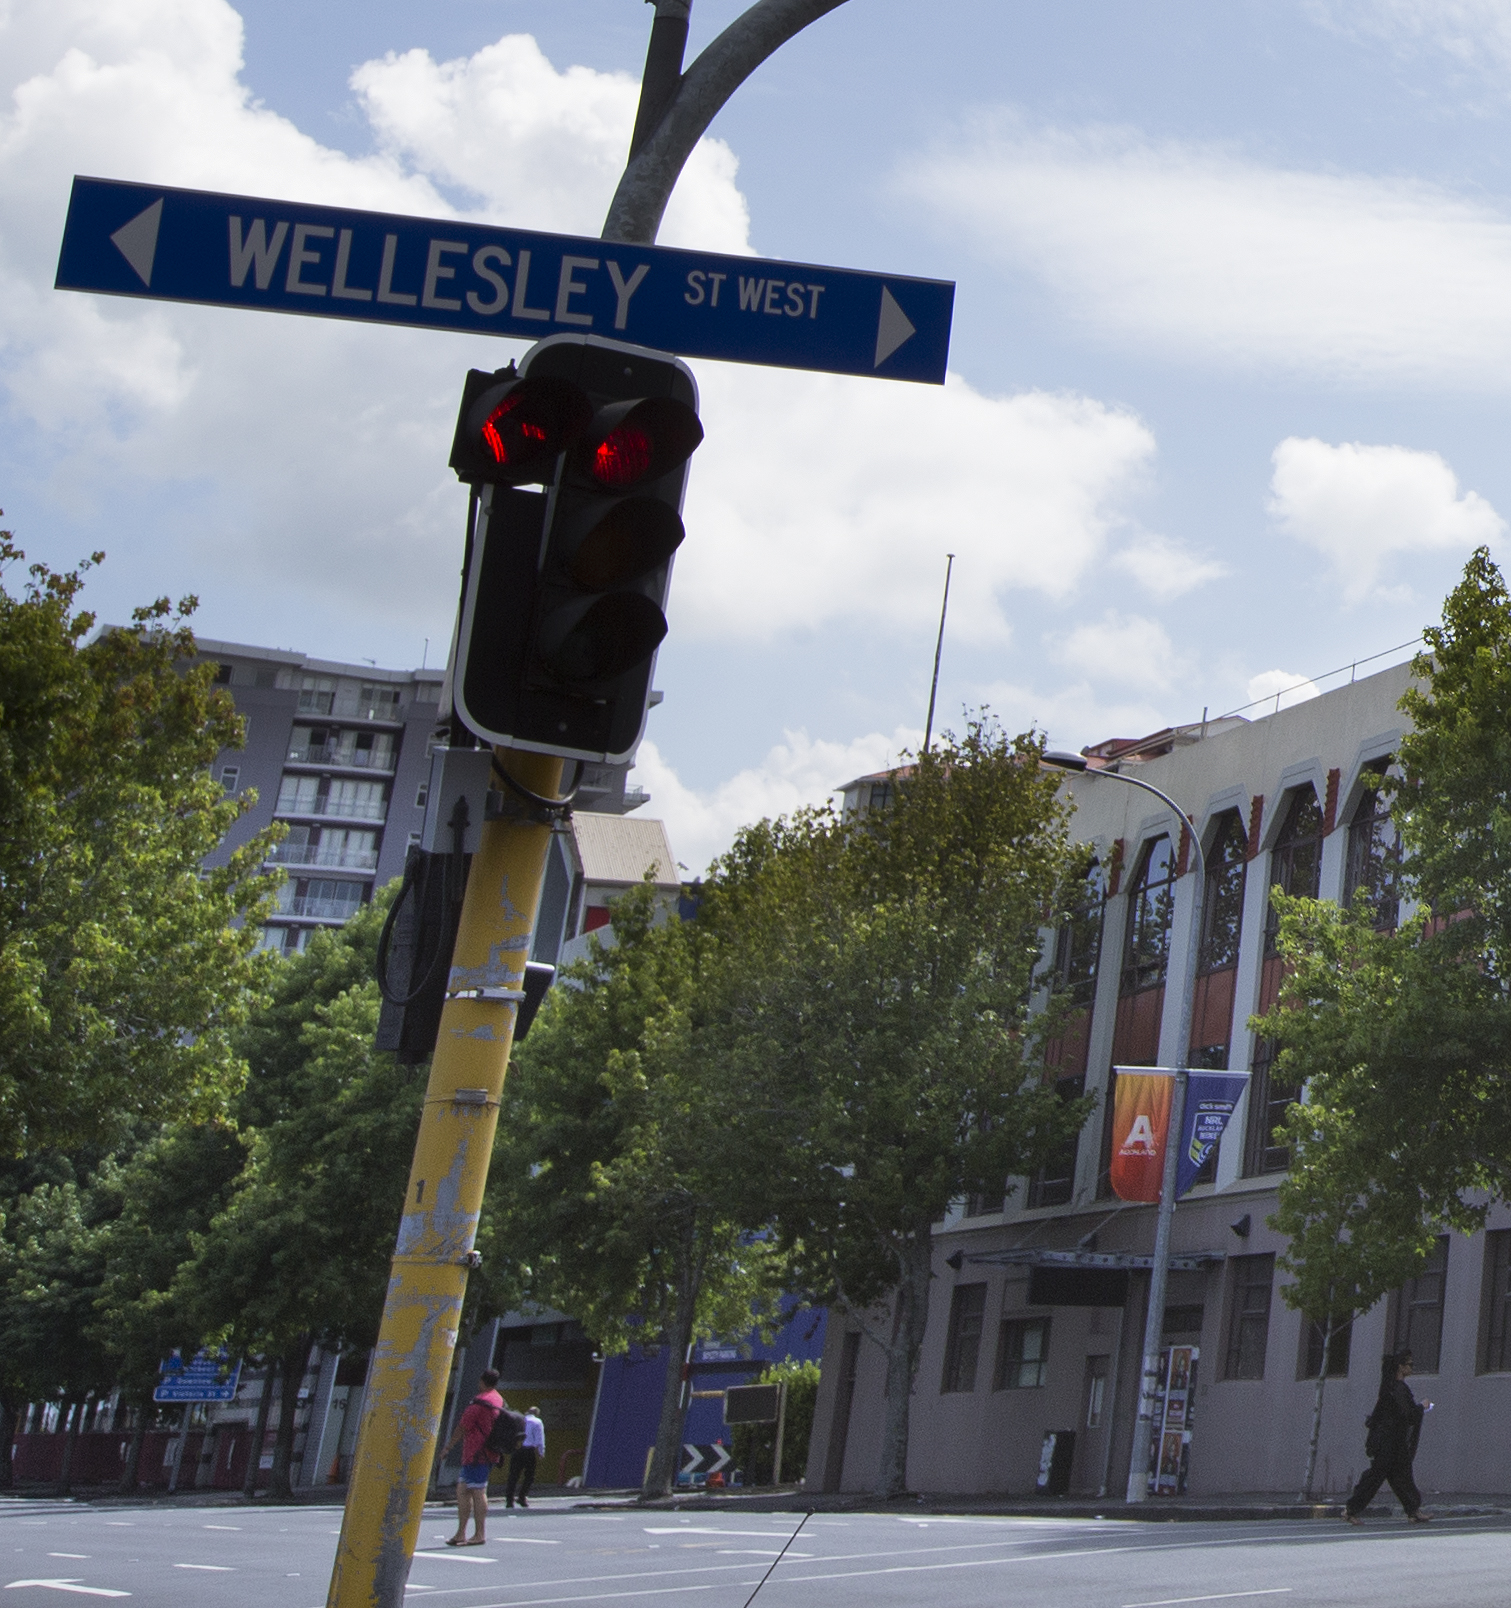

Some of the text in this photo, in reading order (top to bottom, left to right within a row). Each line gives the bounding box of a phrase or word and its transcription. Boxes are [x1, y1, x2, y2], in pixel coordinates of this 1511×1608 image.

[228, 215, 826, 330] WELLESLEY ST WEST
[1122, 1114, 1155, 1150] A
[1204, 1115, 1224, 1126] NRL
[416, 1179, 426, 1204] 1
